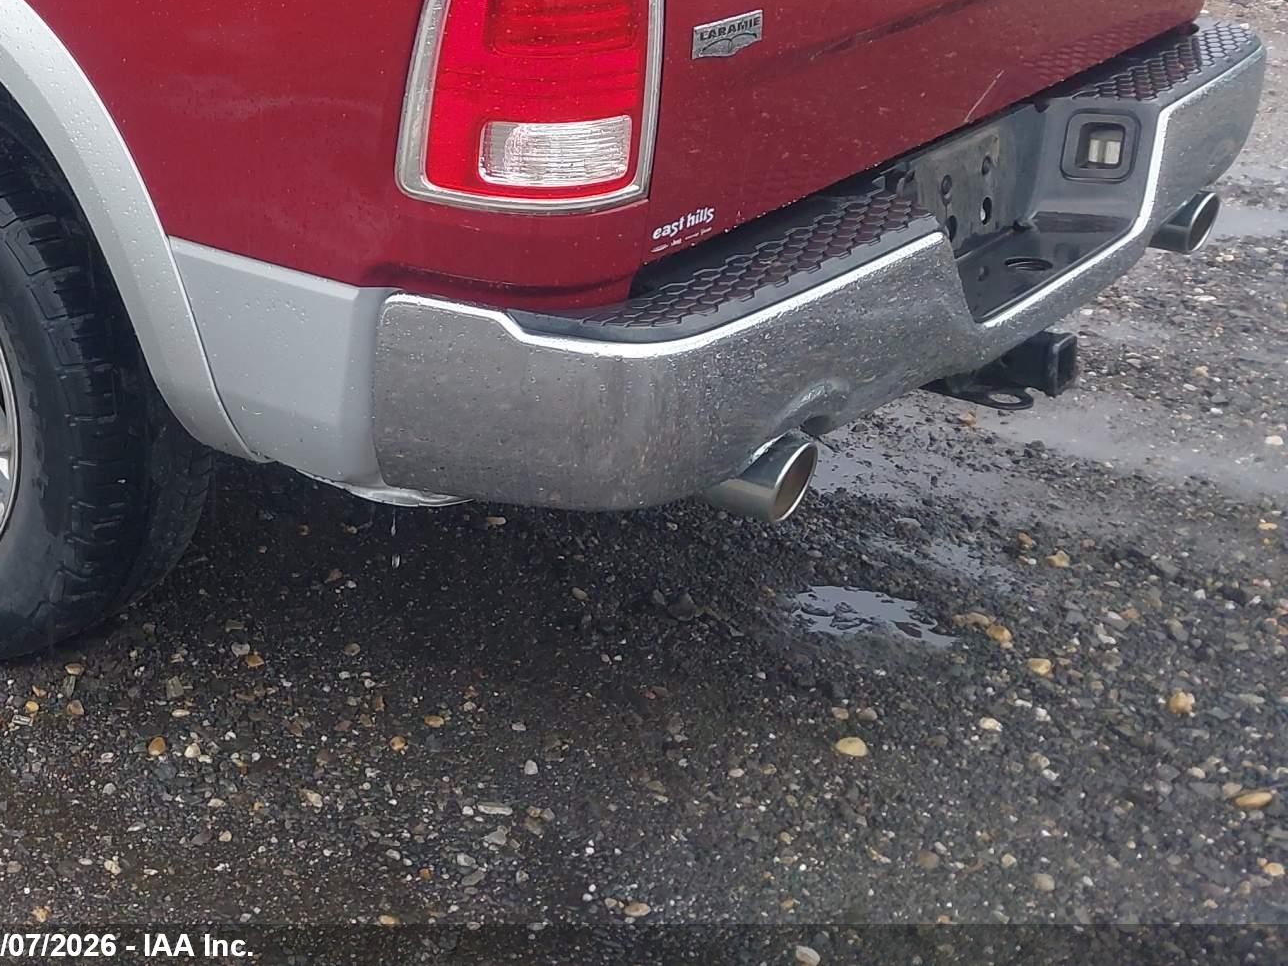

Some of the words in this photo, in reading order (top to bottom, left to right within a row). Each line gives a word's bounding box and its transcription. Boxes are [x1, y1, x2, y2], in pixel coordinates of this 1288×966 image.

[699, 16, 762, 41] LARAMIE
[652, 216, 685, 240] east
[686, 207, 715, 228] hills
